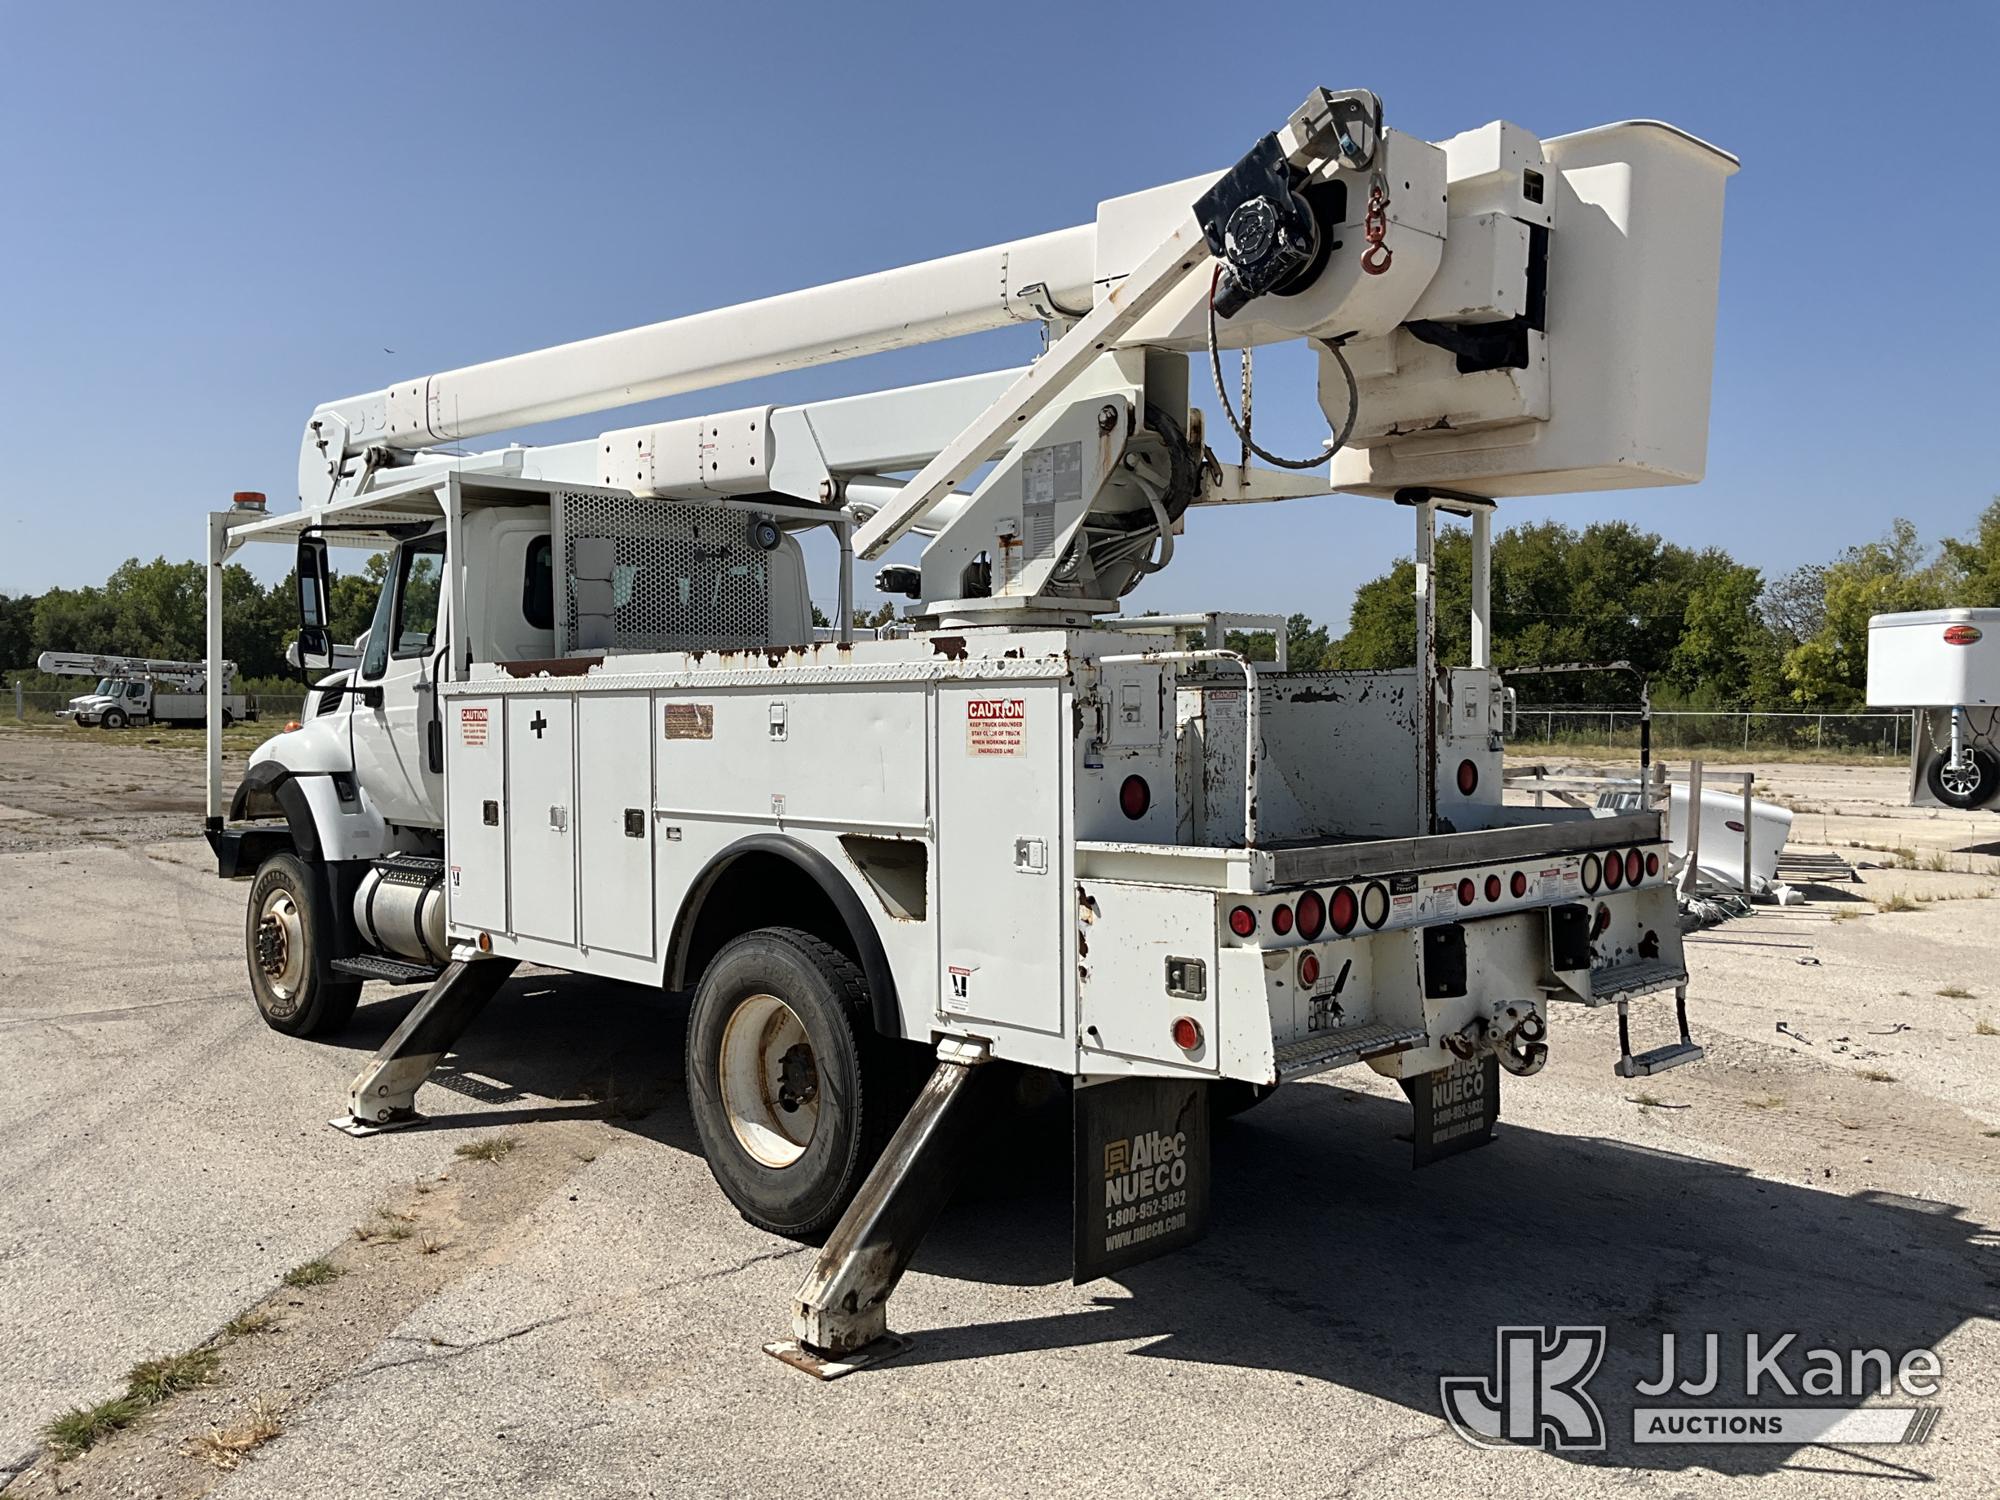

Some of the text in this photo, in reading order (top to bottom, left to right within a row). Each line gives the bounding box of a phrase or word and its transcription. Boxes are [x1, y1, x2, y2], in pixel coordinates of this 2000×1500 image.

[463, 710, 487, 719] CAUTION
[969, 703, 1023, 717] CAUTION
[1432, 1073, 1484, 1109] NUECO
[1130, 1131, 1186, 1171] Altec
[1105, 1158, 1186, 1208] NUECO
[1105, 1212, 1186, 1252] www.nueco.com
